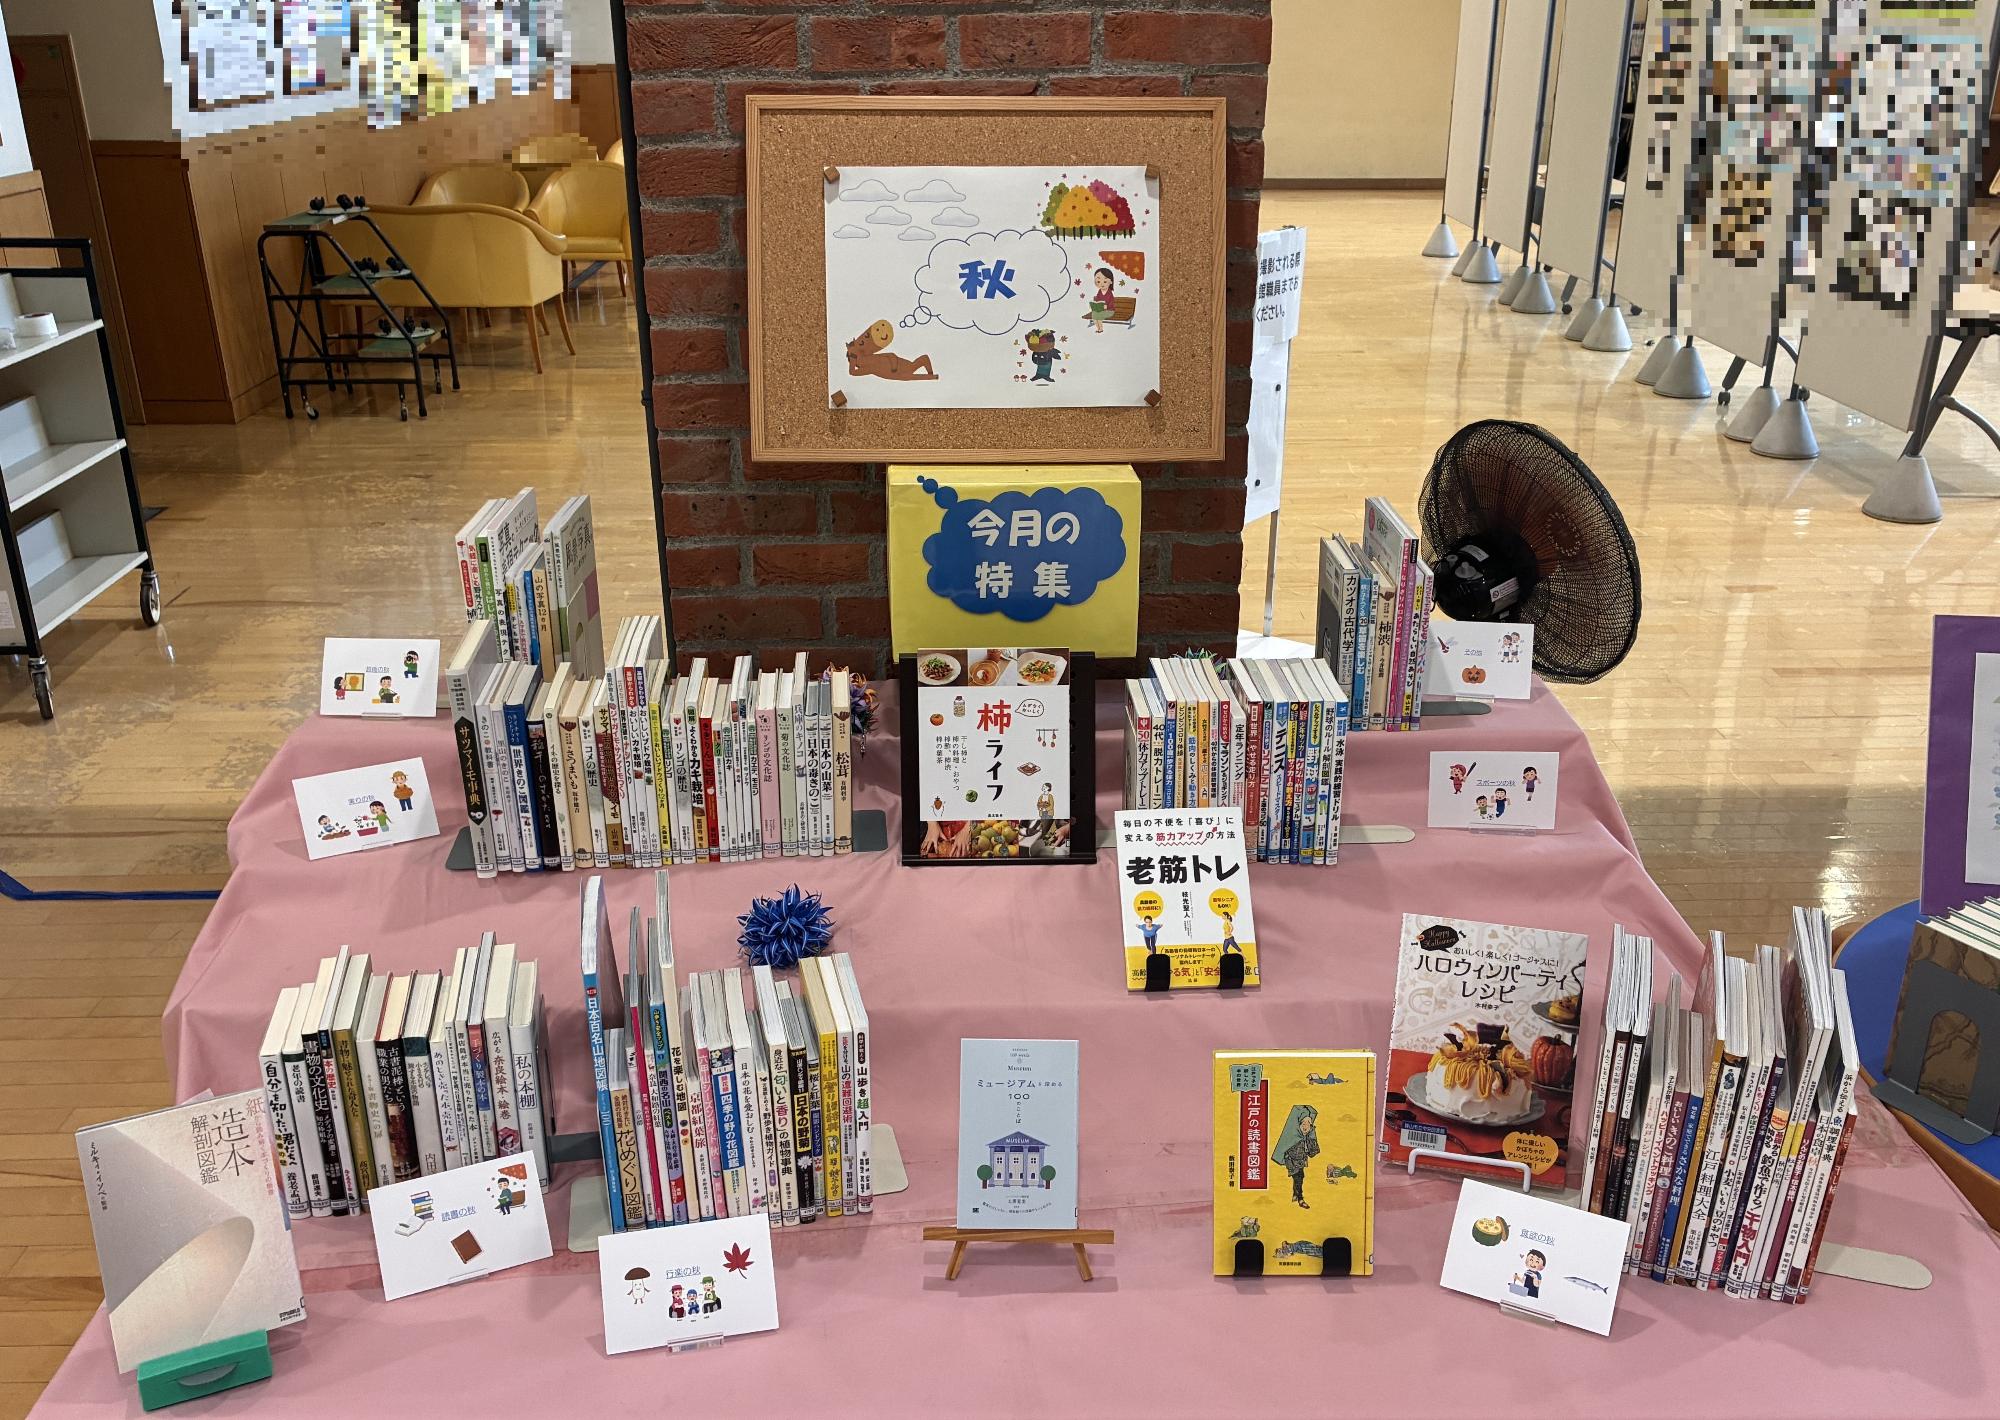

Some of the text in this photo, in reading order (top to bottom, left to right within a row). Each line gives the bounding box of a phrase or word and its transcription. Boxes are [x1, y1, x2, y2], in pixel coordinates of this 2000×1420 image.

[958, 259, 1018, 301] 秋
[1256, 304, 1286, 322] ください。
[967, 508, 1081, 548] 今月の
[974, 561, 1072, 600] 特集
[1342, 575, 1357, 652] カツオの古代学
[1378, 621, 1393, 647] 柿渋
[629, 710, 643, 769] おいしいカキ栽培
[639, 710, 652, 775] おいしいブドウ栽培
[781, 733, 791, 773] 菊の文化誌
[794, 704, 805, 758] 兵庫のキノコ
[960, 735, 968, 764] 干し柿と
[976, 698, 1012, 802] 柿ライフ
[1153, 724, 1165, 741] 40代
[1234, 723, 1245, 781] 定年ランニング
[1247, 722, 1259, 789] 世界一やせる走り方
[1273, 729, 1287, 774] テニス
[1323, 707, 1335, 752] 野球のルール
[459, 726, 481, 805] サツマイモ事典
[513, 748, 530, 814] 世界きのこ図鑑
[585, 745, 598, 787] コメの歴史
[676, 742, 688, 793] リンゴの歴史
[690, 725, 704, 805] よくわかるカキ栽培
[763, 734, 773, 782] リンゴの文化誌
[807, 738, 820, 808] 日本の毒きのこ
[821, 738, 833, 793] 日本の山菜
[835, 752, 850, 778] 松茸
[952, 735, 960, 792] 柿の料理・おやつ
[1331, 739, 1345, 822] 水泳 実践的練習ドリル
[1476, 779, 1516, 787] スポーツの秋
[1123, 816, 1235, 828] 毎日の不便を「喜び」に
[1124, 830, 1236, 843] 変える筋力アップの方法
[1126, 854, 1241, 886] 老筋トレ
[1414, 954, 1568, 991] ハロウィンパーティ
[1461, 980, 1516, 1004] レシピ
[587, 997, 609, 1092] 日本百名山地図帳
[303, 1040, 330, 1112] 書物の文化史
[323, 1059, 337, 1089] 本の歴史
[376, 1048, 394, 1103] 職業の男たち
[388, 1047, 406, 1112] 古書泥棒という
[492, 1031, 512, 1121] 広がる奈良絵本・絵巻
[515, 1055, 535, 1108] 私の本棚
[658, 1070, 672, 1108] 関西の名山
[671, 1046, 688, 1112] 花を楽しむ地図
[741, 1062, 755, 1134] 日本の花を愛おしむ
[841, 1066, 853, 1124] 山の遭難回避術
[856, 1066, 870, 1131] 山歩き超入門
[211, 1107, 256, 1177] 造本
[689, 1092, 707, 1150] 京都紅葉旅
[721, 1095, 740, 1169] 四季の野の花図鑑
[762, 1112, 775, 1168] 野歩き植物ガイド
[796, 1096, 810, 1150] 日本の野菊
[1247, 1094, 1261, 1180] 江戸の読書図鑑
[1516, 1138, 1546, 1147] 体に優しい
[1659, 1100, 1683, 1177] おいしいきのこ料理
[1771, 1130, 1784, 1158] 基礎から
[190, 1114, 220, 1185] 解剖図鑑
[616, 1129, 643, 1219] 花めぐり図鑑
[1507, 1151, 1552, 1163] アレンジレシピが
[1516, 1146, 1545, 1155] かぼちゃの
[1670, 1156, 1688, 1205] さかな料理
[1691, 1149, 1721, 1222] 江戸料理大全
[441, 1206, 477, 1222] 読書の秋
[1707, 1168, 1736, 1248] 小麦・いも・豆のおやつ
[1519, 1228, 1557, 1246] 食欲の秋
[1733, 1210, 1761, 1267] 干物入門
[665, 1264, 702, 1279] 行楽の秋
